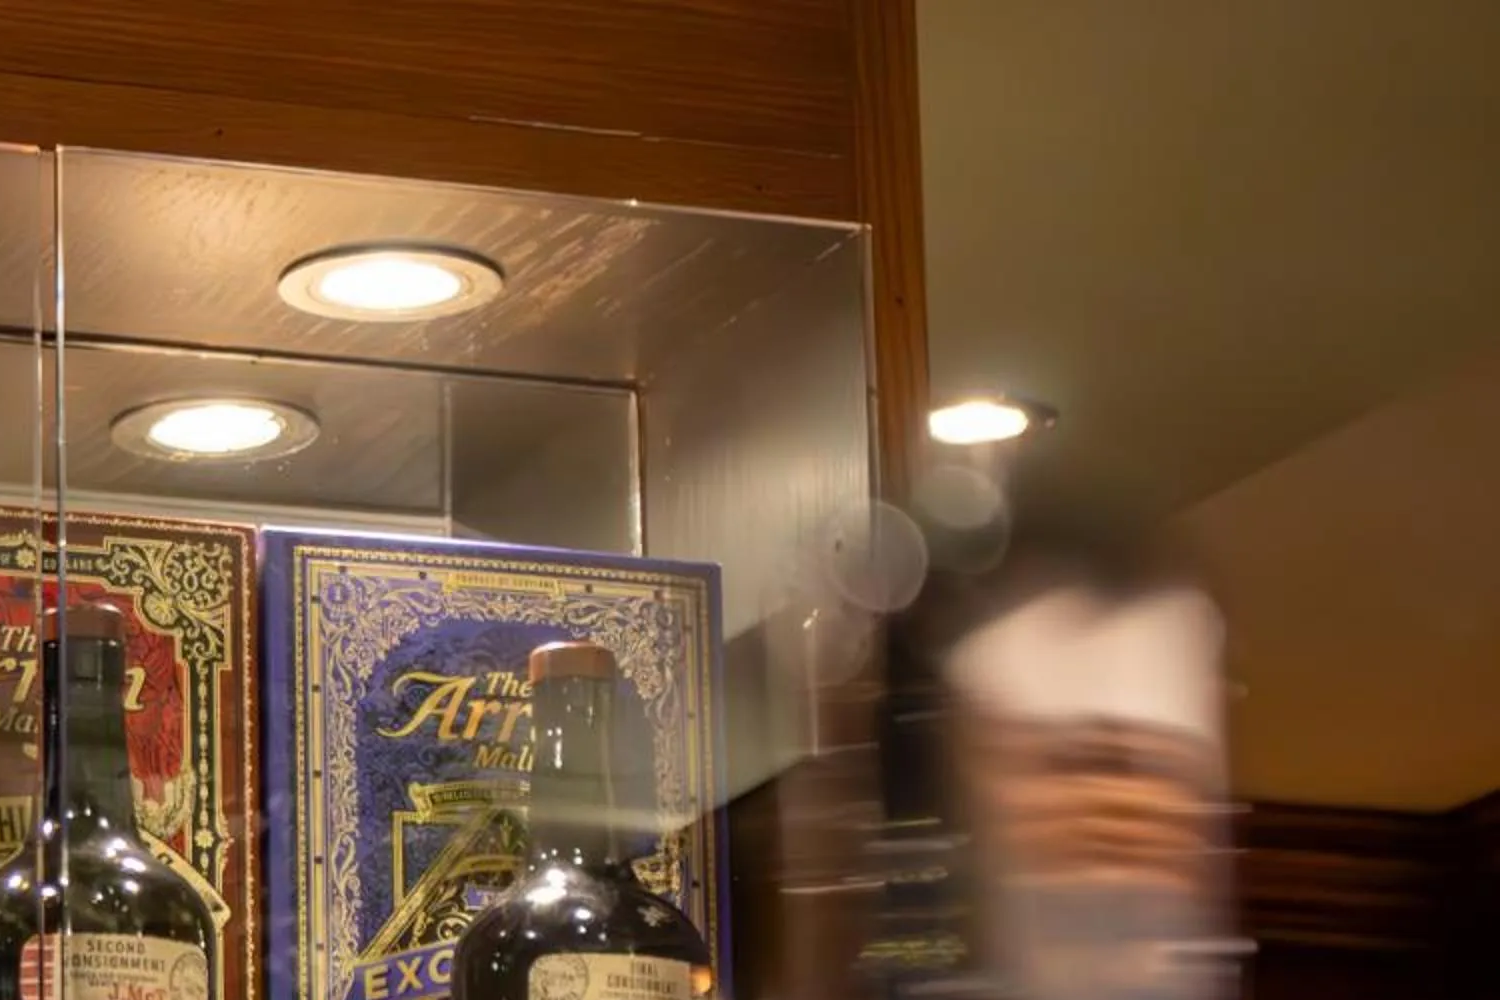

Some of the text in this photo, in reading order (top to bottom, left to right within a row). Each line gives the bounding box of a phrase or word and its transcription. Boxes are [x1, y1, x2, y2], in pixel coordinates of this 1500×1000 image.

[1, 625, 37, 653] Th
[485, 671, 534, 698] The
[375, 671, 536, 742] Arr
[87, 938, 148, 956] SECOND
